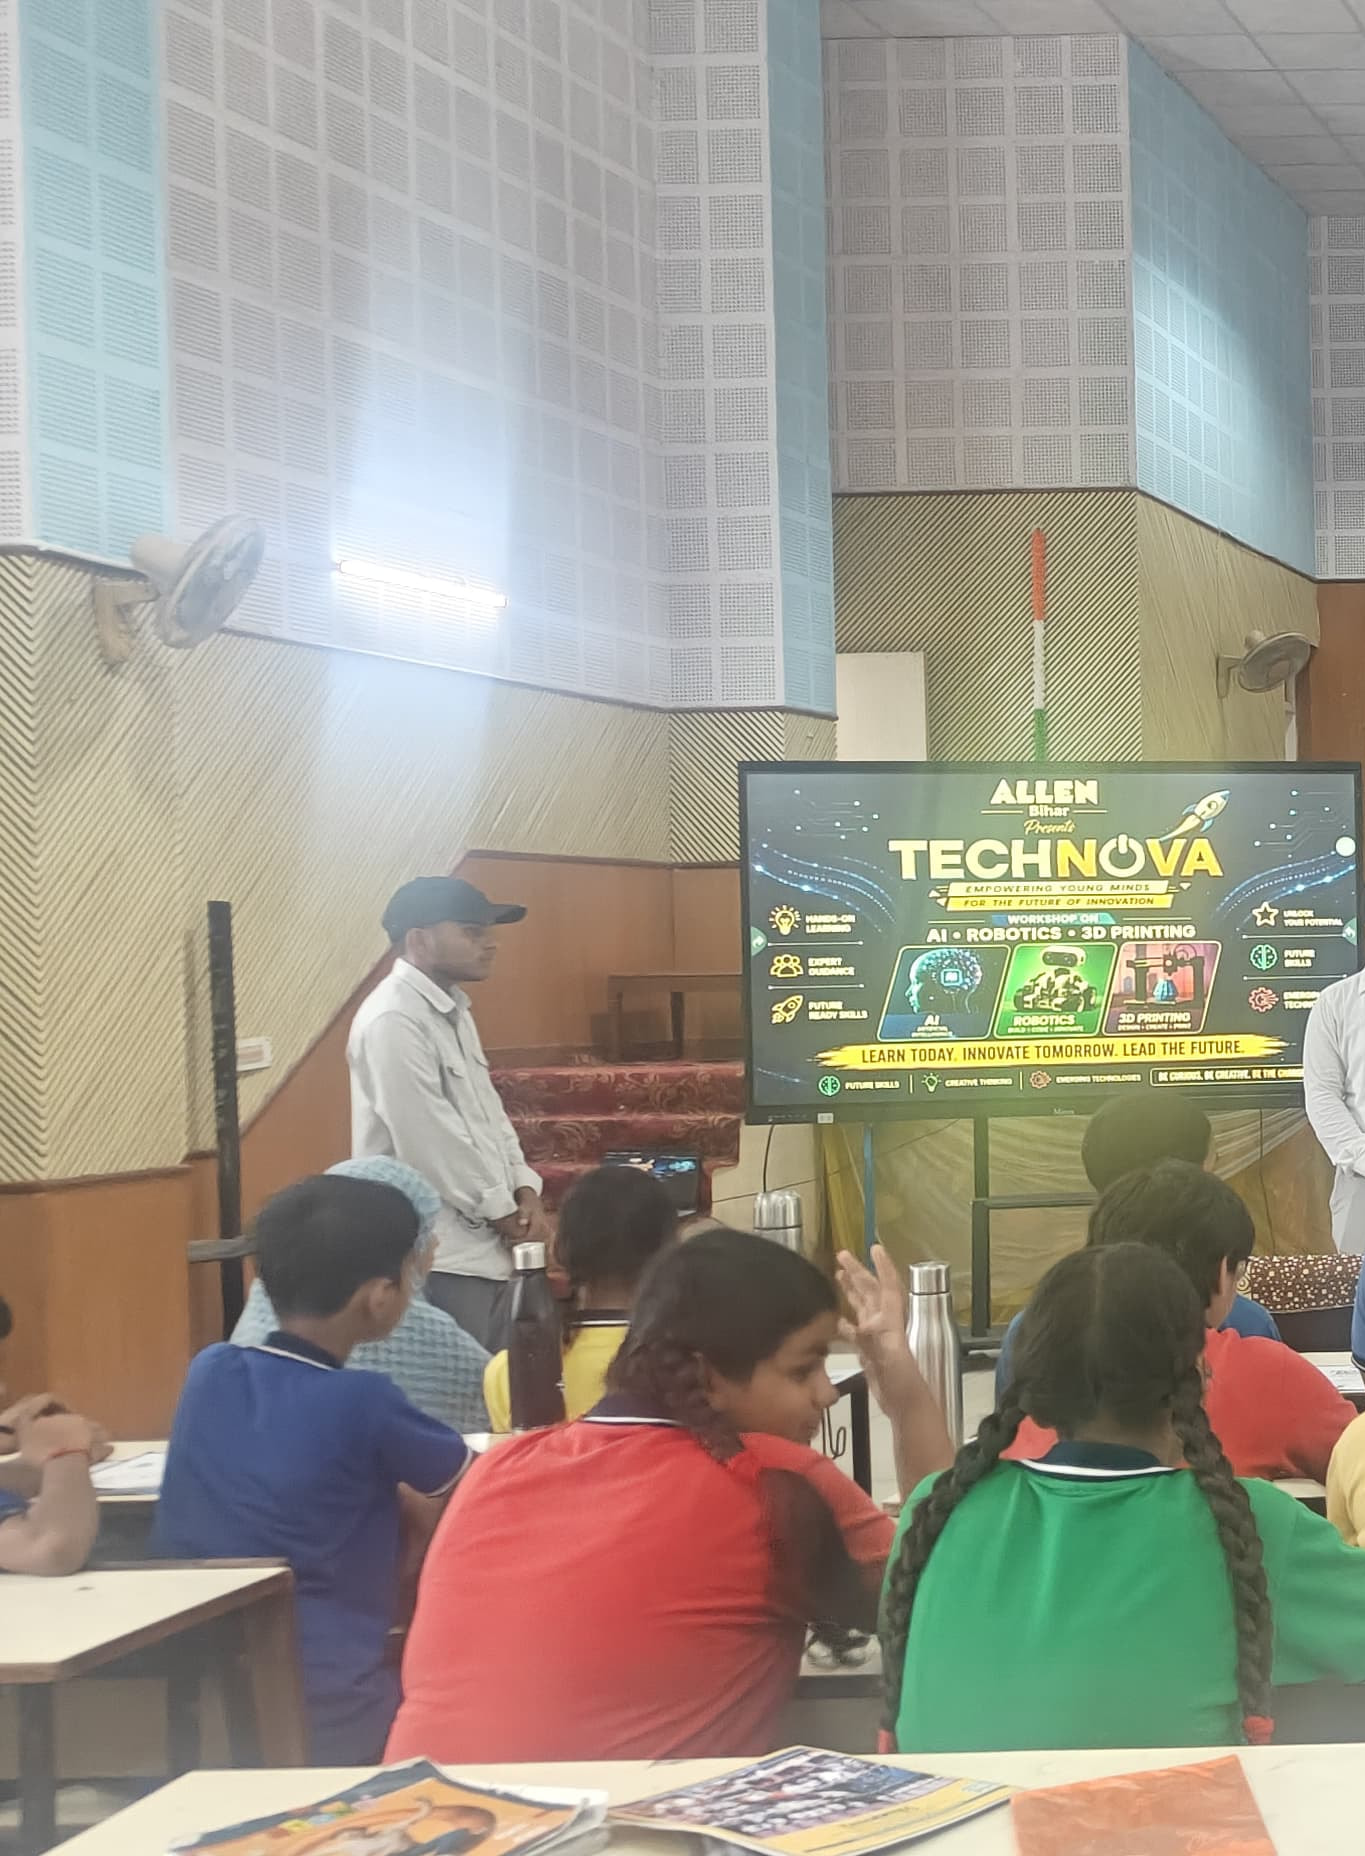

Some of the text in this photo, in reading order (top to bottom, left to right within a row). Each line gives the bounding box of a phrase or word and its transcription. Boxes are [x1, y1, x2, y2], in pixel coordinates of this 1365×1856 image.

[990, 779, 1098, 805] ALLEN
[1029, 804, 1070, 817] Bihar
[1023, 819, 1075, 834] Presents
[888, 834, 1224, 880] TECHNOVA
[965, 885, 1053, 893] EMPOWERING
[1061, 884, 1103, 892] YOUNG
[964, 899, 986, 907] FOR
[1018, 898, 1060, 906] FUTURE
[1067, 898, 1081, 906] OF
[1086, 897, 1154, 905] INNOVATION
[1007, 913, 1098, 925] WORKSHOP ON
[926, 925, 1196, 943] AI ROBOTICS 3D PRINTING
[924, 1015, 939, 1026] AI
[1013, 1014, 1076, 1026] ROBOTICS
[1118, 1012, 1191, 1024] 3D PRINTING
[861, 1040, 1246, 1063] LEARN TODAY. INNOVATE TOMORROW. LEAD THE FUTURE.
